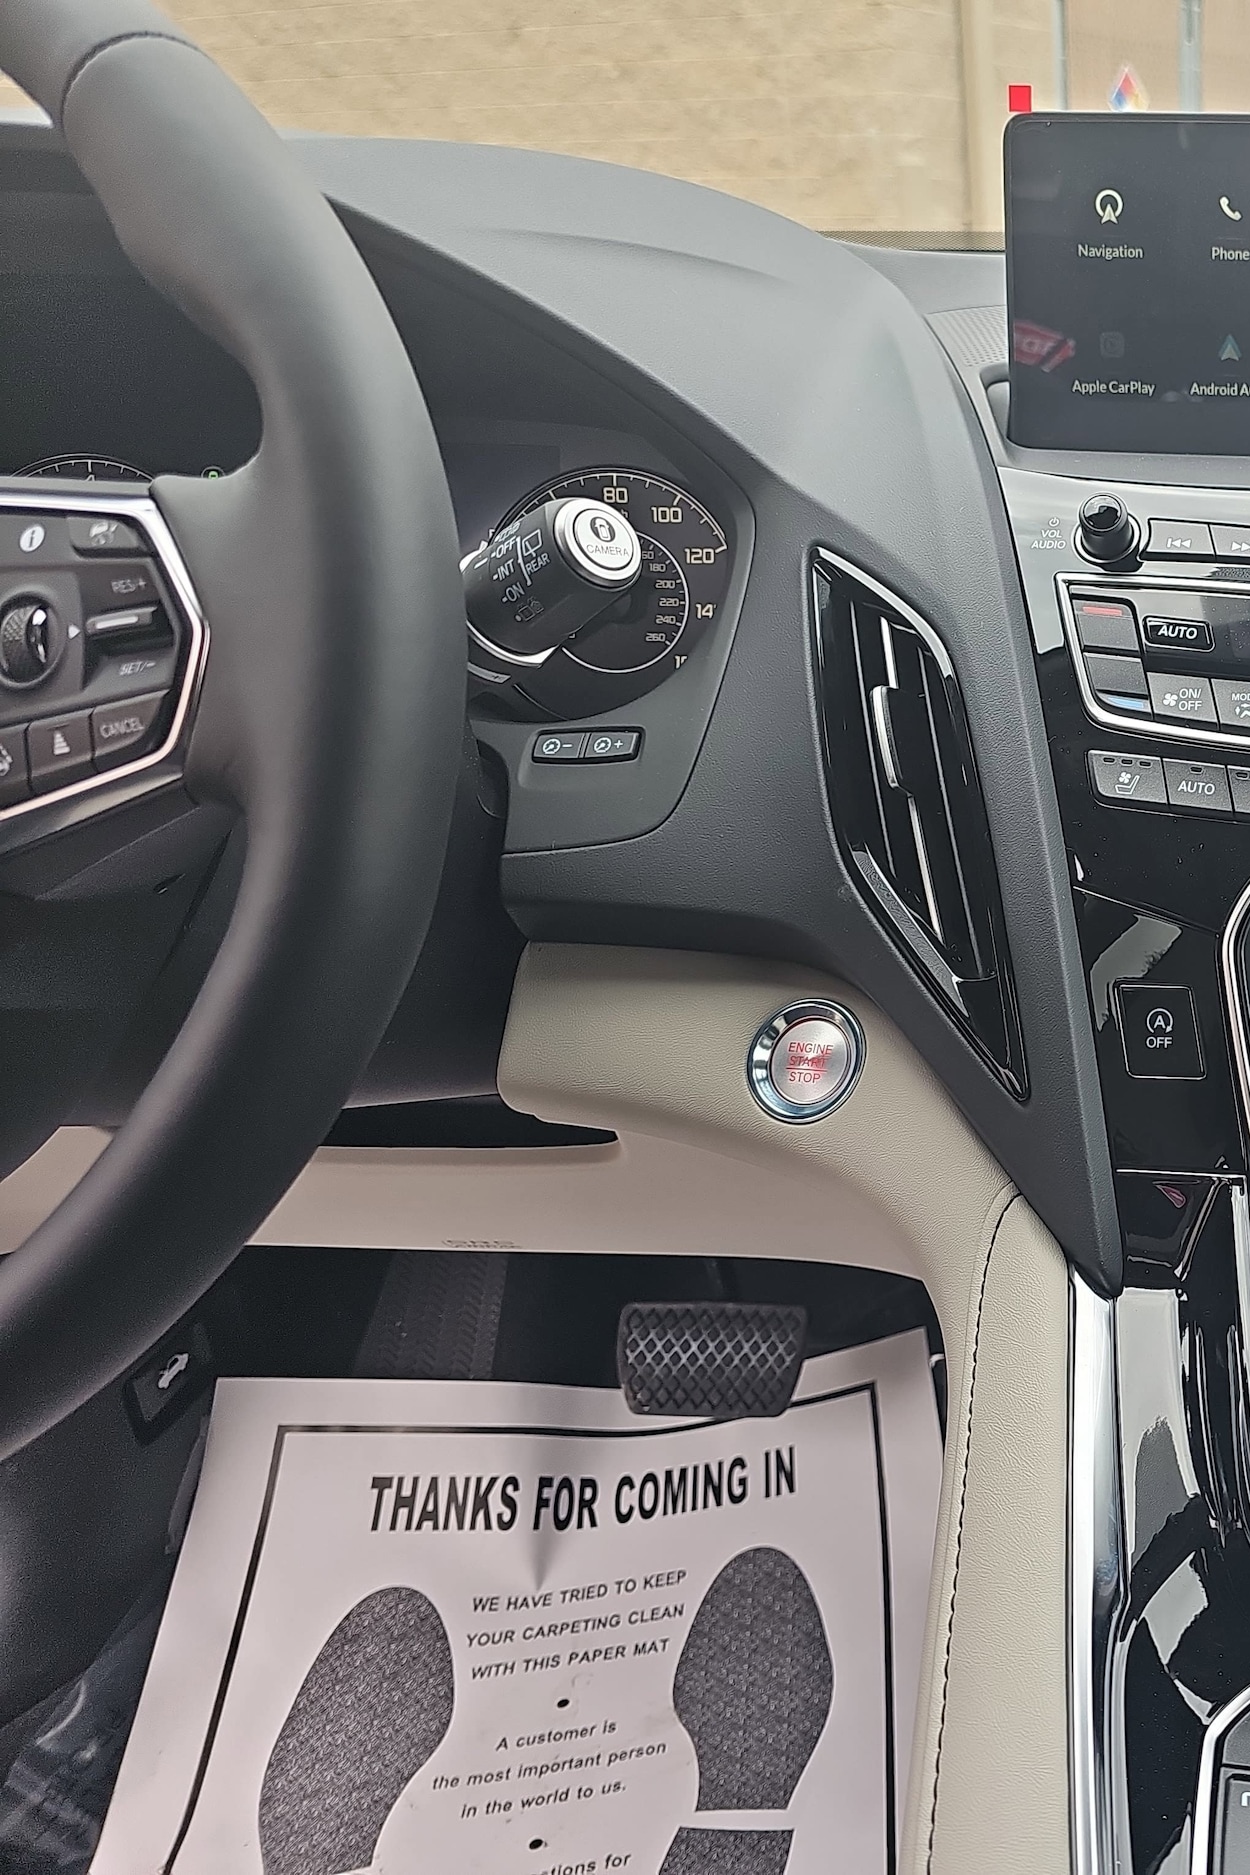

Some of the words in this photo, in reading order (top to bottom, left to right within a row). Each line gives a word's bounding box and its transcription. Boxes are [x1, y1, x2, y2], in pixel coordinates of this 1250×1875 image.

[1077, 244, 1144, 260] Navigation
[1211, 246, 1250, 261] Phone
[1072, 379, 1107, 396] Apple
[1109, 380, 1156, 397] CarPlay
[1190, 381, 1238, 397] Android
[603, 487, 628, 504] 80
[651, 507, 683, 523] 100
[1041, 529, 1063, 539] VOL
[586, 543, 630, 558] CAMERA
[1031, 539, 1067, 550] AUDIO
[526, 552, 550, 575] REAR
[684, 548, 715, 564] 120
[649, 563, 666, 572] 180
[505, 582, 525, 602] ON
[655, 580, 675, 589] 200
[659, 598, 679, 607] 220
[655, 615, 676, 624] 240
[695, 604, 717, 619] 14
[646, 633, 666, 642] 260
[1157, 624, 1199, 641] AUTO
[1179, 688, 1202, 701] ON/
[1178, 701, 1203, 712] OFF
[101, 717, 145, 739] CANCEL
[1177, 780, 1216, 795] AUTO
[788, 1042, 834, 1056] ENGINE
[1146, 1036, 1173, 1048] OFF
[788, 1055, 829, 1069] START
[788, 1071, 821, 1084] STOP
[369, 1475, 520, 1533] THANKS
[532, 1475, 599, 1532] FOR
[614, 1455, 748, 1525] COMING
[764, 1445, 797, 1499] IN
[472, 1596, 500, 1614] WE
[506, 1591, 553, 1612] HAVE
[560, 1583, 608, 1605] TRIED
[615, 1578, 637, 1594] TO
[643, 1569, 687, 1590] KEEP
[466, 1630, 516, 1648] YOUR
[522, 1613, 622, 1641] CARPETING
[628, 1603, 685, 1627] CLEAN
[471, 1660, 516, 1681] WITH
[522, 1653, 561, 1673] THIS
[568, 1645, 627, 1666] PAPER
[633, 1637, 670, 1657] MAT
[495, 1737, 509, 1751] A
[516, 1722, 597, 1748] customer
[602, 1719, 617, 1735] is
[432, 1774, 460, 1791] the
[466, 1767, 511, 1787] most
[517, 1754, 602, 1780] important
[607, 1742, 667, 1768] person
[461, 1803, 477, 1820] in
[485, 1798, 513, 1816] the
[521, 1788, 570, 1809] world
[577, 1784, 595, 1801] to
[601, 1780, 627, 1796] us.
[604, 1853, 632, 1870] for
